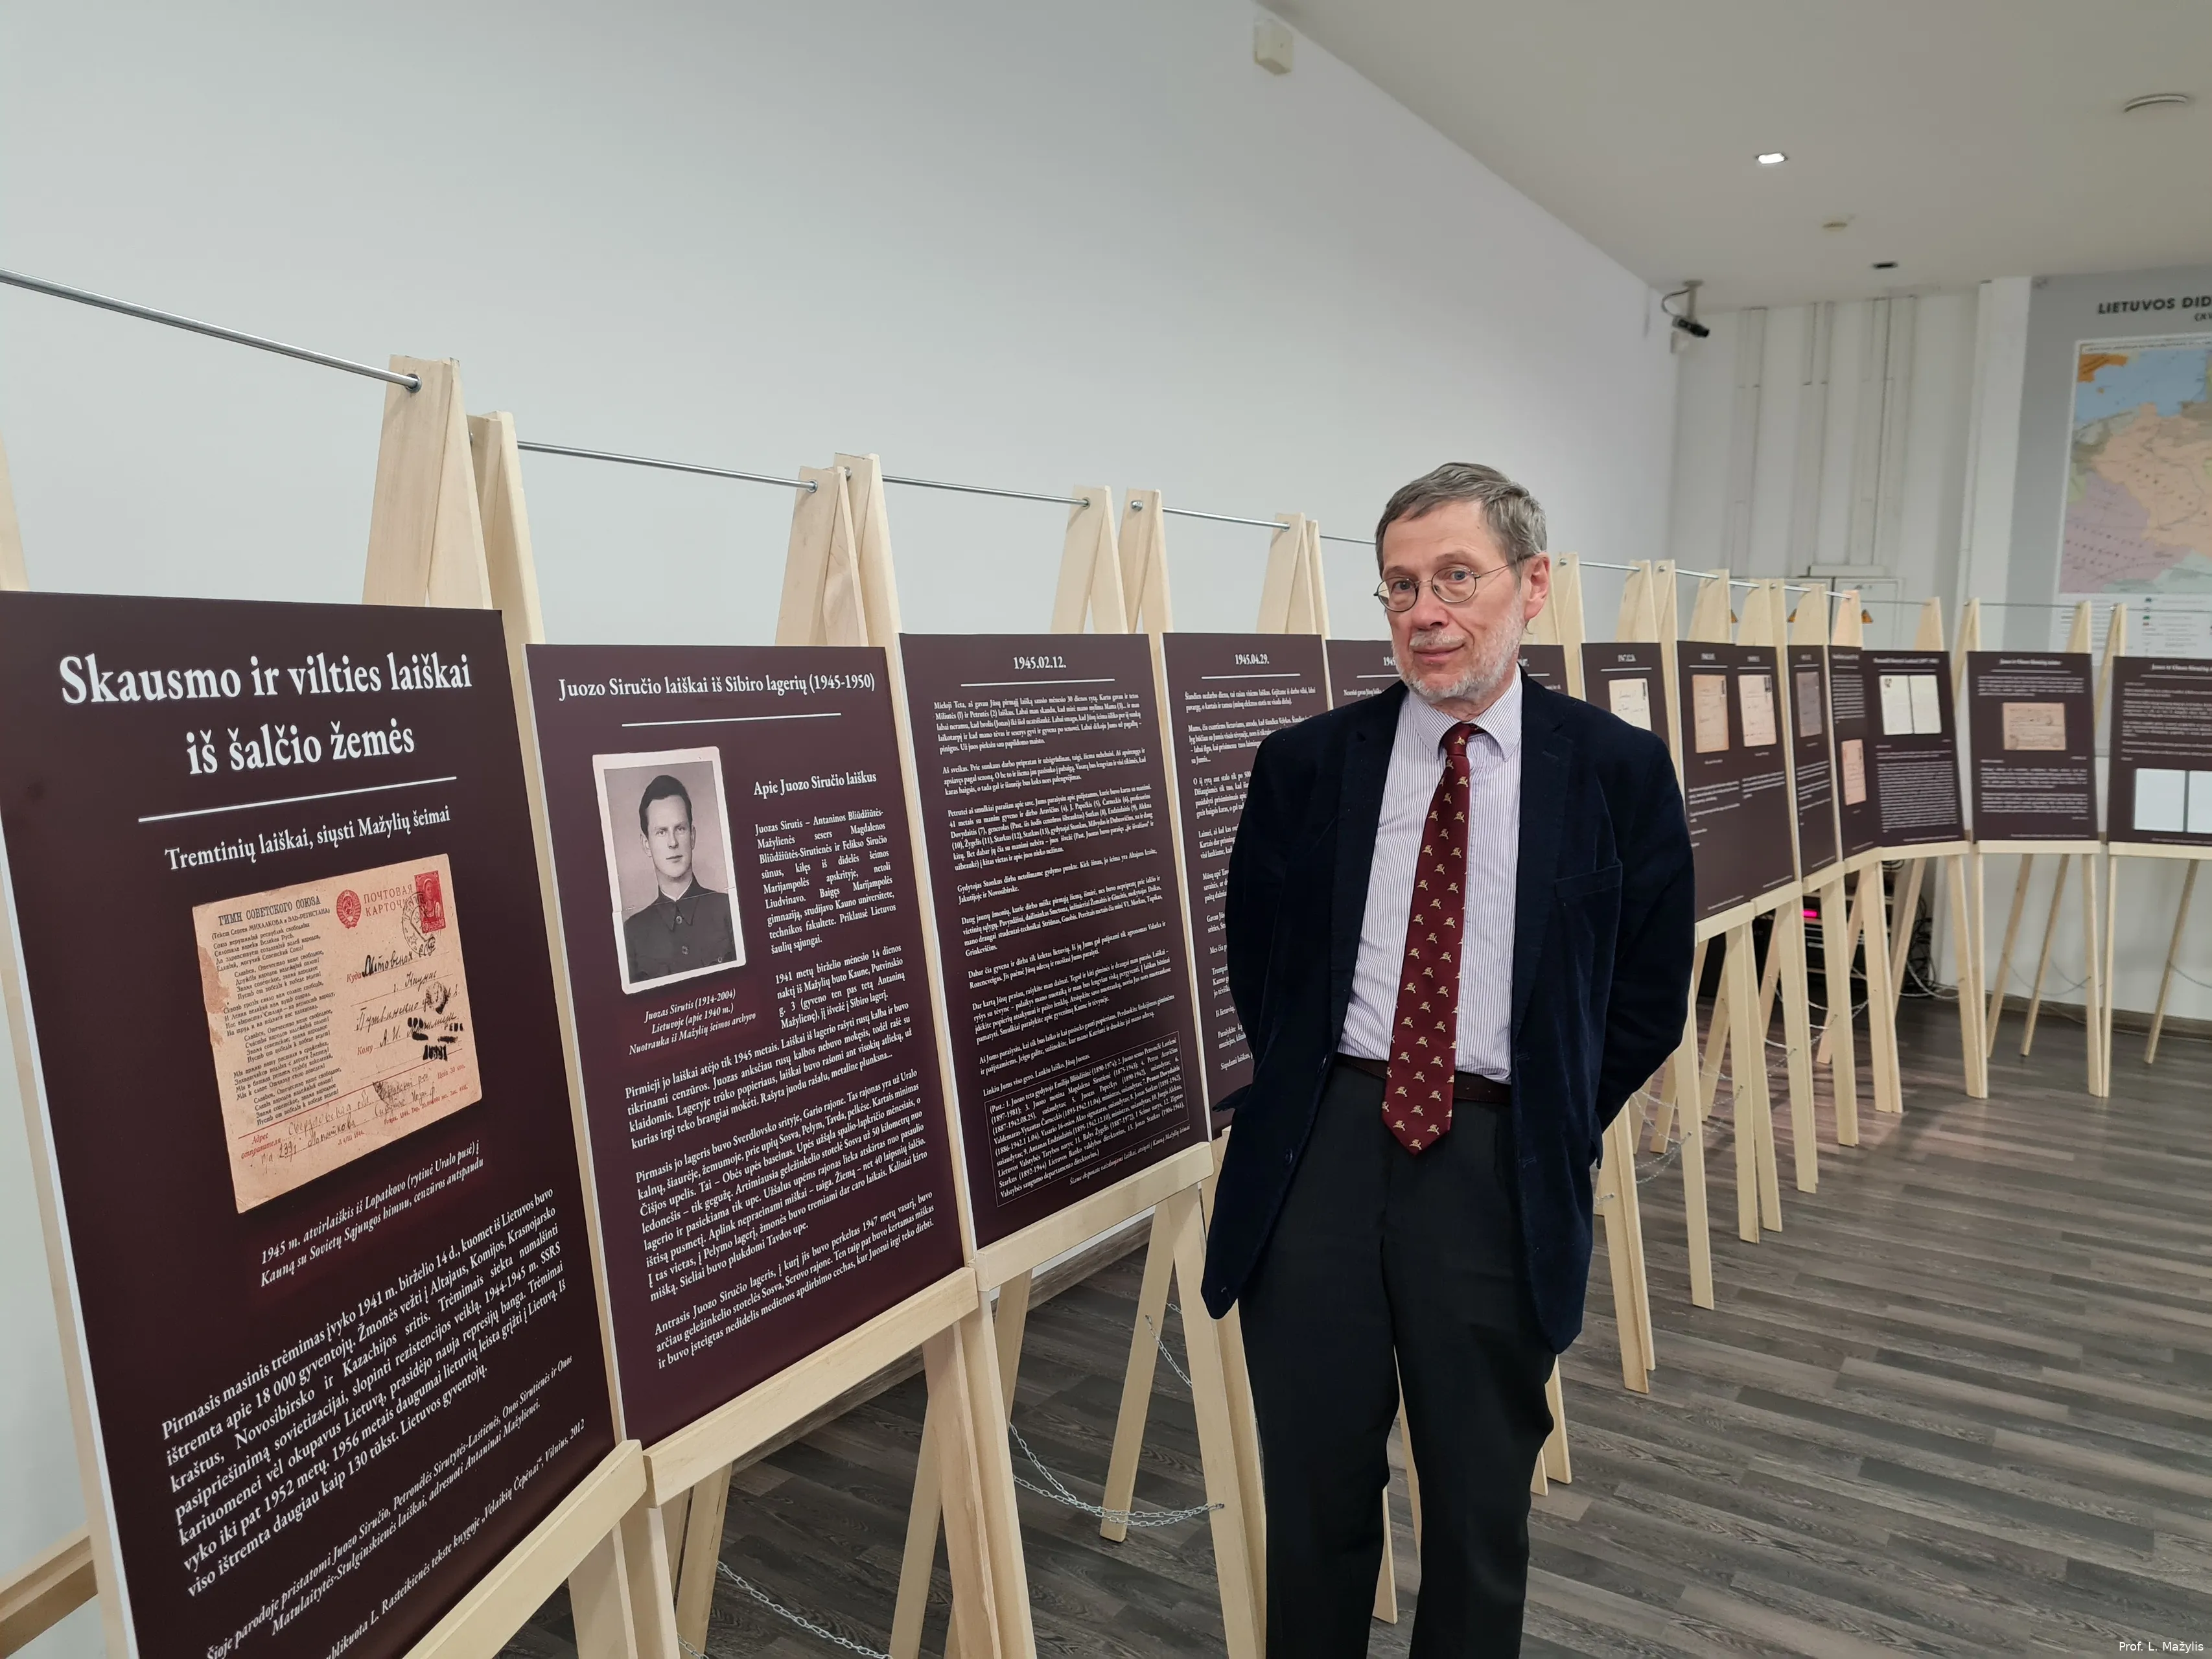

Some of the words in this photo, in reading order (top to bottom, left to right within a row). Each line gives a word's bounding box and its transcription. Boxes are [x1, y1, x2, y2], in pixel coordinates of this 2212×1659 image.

[2098, 297, 2176, 314] LIETUVOS
[1013, 656, 1067, 670] 1945.02.12.
[1235, 653, 1270, 665] 1945.04.29.
[59, 653, 241, 704] Skausmo
[250, 655, 279, 696] ir
[286, 652, 382, 695] vilties
[386, 651, 472, 690] laiškai
[558, 679, 606, 702] Juozo
[609, 677, 662, 695] Siručio
[664, 675, 709, 693] laiškai
[711, 676, 723, 693] iš
[725, 675, 763, 692] Sibiro
[765, 674, 808, 697] lagerių
[809, 673, 875, 693] (1945-1950)
[186, 729, 218, 775] iš
[227, 723, 322, 771] šalčio
[331, 717, 415, 760] žemės
[753, 780, 778, 800] Apie
[780, 778, 809, 796] Juozo
[811, 773, 845, 789] Siručio
[845, 770, 877, 785] laiškus
[164, 838, 257, 870] Tremtinių
[258, 828, 314, 854] laiškai,
[316, 820, 355, 848] siųsti
[357, 812, 412, 839] Mažylių
[412, 805, 450, 827] šeimai
[754, 824, 778, 837] Juozas
[780, 818, 803, 830] Sirutis
[813, 813, 846, 826] Antaninos
[847, 807, 884, 821] Bliūdžiūtės-
[364, 884, 413, 904] ПОЧТОВАЯ
[218, 912, 243, 925] ГИМН
[246, 901, 293, 920] СОВЕТСКОГО
[296, 896, 321, 909] СОЮЗА
[346, 972, 362, 983] Куда
[644, 1008, 669, 1024] Juozas
[669, 1000, 694, 1014] Sirutis
[695, 988, 736, 1010] (1914-2004)
[651, 1017, 684, 1034] Lietuvoje
[685, 1012, 703, 1027] (apie
[704, 1006, 721, 1019] 1940
[722, 1002, 734, 1014] m.)
[357, 1044, 373, 1056] Кому
[629, 1036, 669, 1055] Nuotrauka
[671, 1032, 678, 1043] iš
[678, 1025, 708, 1041] Mažylių
[709, 1020, 730, 1032] šeimos
[731, 1013, 756, 1025] archyvo
[240, 1139, 281, 1159] отправителя
[251, 1132, 269, 1144] Адрес
[262, 1240, 286, 1264] 1945
[288, 1238, 301, 1250] m.
[303, 1206, 354, 1242] atvirlaiškis
[356, 1199, 363, 1214] iš
[365, 1181, 406, 1210] Lopatkovo
[407, 1163, 434, 1190] (rytinė
[435, 1152, 456, 1172] Uralo
[457, 1141, 475, 1165] pusė)
[476, 1139, 480, 1155] į
[261, 1260, 295, 1287] Kauną
[297, 1254, 307, 1268] su
[309, 1235, 342, 1260] Sovietų
[344, 1214, 381, 1242] Sąjungos
[383, 1198, 412, 1220] himnu,
[413, 1179, 445, 1203] cenzūros
[447, 1156, 483, 1185] antspaudu
[655, 1310, 690, 1336] Antrasis
[692, 1299, 717, 1319] Juozo
[719, 1282, 748, 1303] Siručio
[749, 1269, 776, 1288] lageris,
[778, 1264, 782, 1277] į
[784, 1255, 800, 1271] kurį
[801, 1251, 810, 1266] jis
[811, 1243, 830, 1257] buvo
[831, 1227, 861, 1251] perkeltas
[862, 1216, 878, 1231] 1947
[879, 1209, 896, 1223] metų
[897, 1198, 916, 1213] vasarį,
[917, 1192, 933, 1204] buvo
[161, 1395, 221, 1440] Pirmasis
[222, 1363, 270, 1402] masinis
[271, 1330, 325, 1371] trėmimas
[326, 1312, 356, 1342] įvyko
[358, 1291, 383, 1317] 1941
[384, 1287, 398, 1301] m.
[398, 1262, 435, 1291] birželio
[436, 1251, 448, 1268] 14
[448, 1244, 461, 1260] d.,
[460, 1225, 494, 1253] kuomet
[493, 1217, 501, 1232] iš
[501, 1200, 535, 1227] Lietuvos
[534, 1189, 553, 1206] buvo
[166, 1422, 224, 1467] ištremta
[226, 1403, 252, 1430] apie
[255, 1387, 271, 1408] 18
[274, 1371, 296, 1396] 000
[299, 1338, 356, 1386] gyventojų.
[357, 1308, 399, 1342] Žmonės
[399, 1289, 423, 1314] vežti
[424, 1286, 429, 1304] į
[430, 1265, 469, 1295] Altajaus,
[469, 1240, 507, 1270] Komijos,
[507, 1207, 555, 1245] Krasnojarsko
[235, 1599, 279, 1649] parodoje
[281, 1552, 331, 1610] pristatomi
[331, 1535, 357, 1566] Juozo
[358, 1508, 391, 1540] Siručio,
[393, 1471, 432, 1511] Petronėlės
[434, 1415, 501, 1477] Sirutytės-Lastienės,
[502, 1400, 518, 1419] Onos
[519, 1373, 550, 1405] Sirutienės
[551, 1367, 557, 1378] ir
[557, 1355, 572, 1372] Onos
[370, 1610, 379, 1625] L.
[382, 1562, 430, 1615] Rasteikienės
[431, 1543, 452, 1568] tekste
[453, 1517, 480, 1548] knygoje
[545, 1437, 569, 1462] Vilnius,
[570, 1418, 585, 1440] 2012
